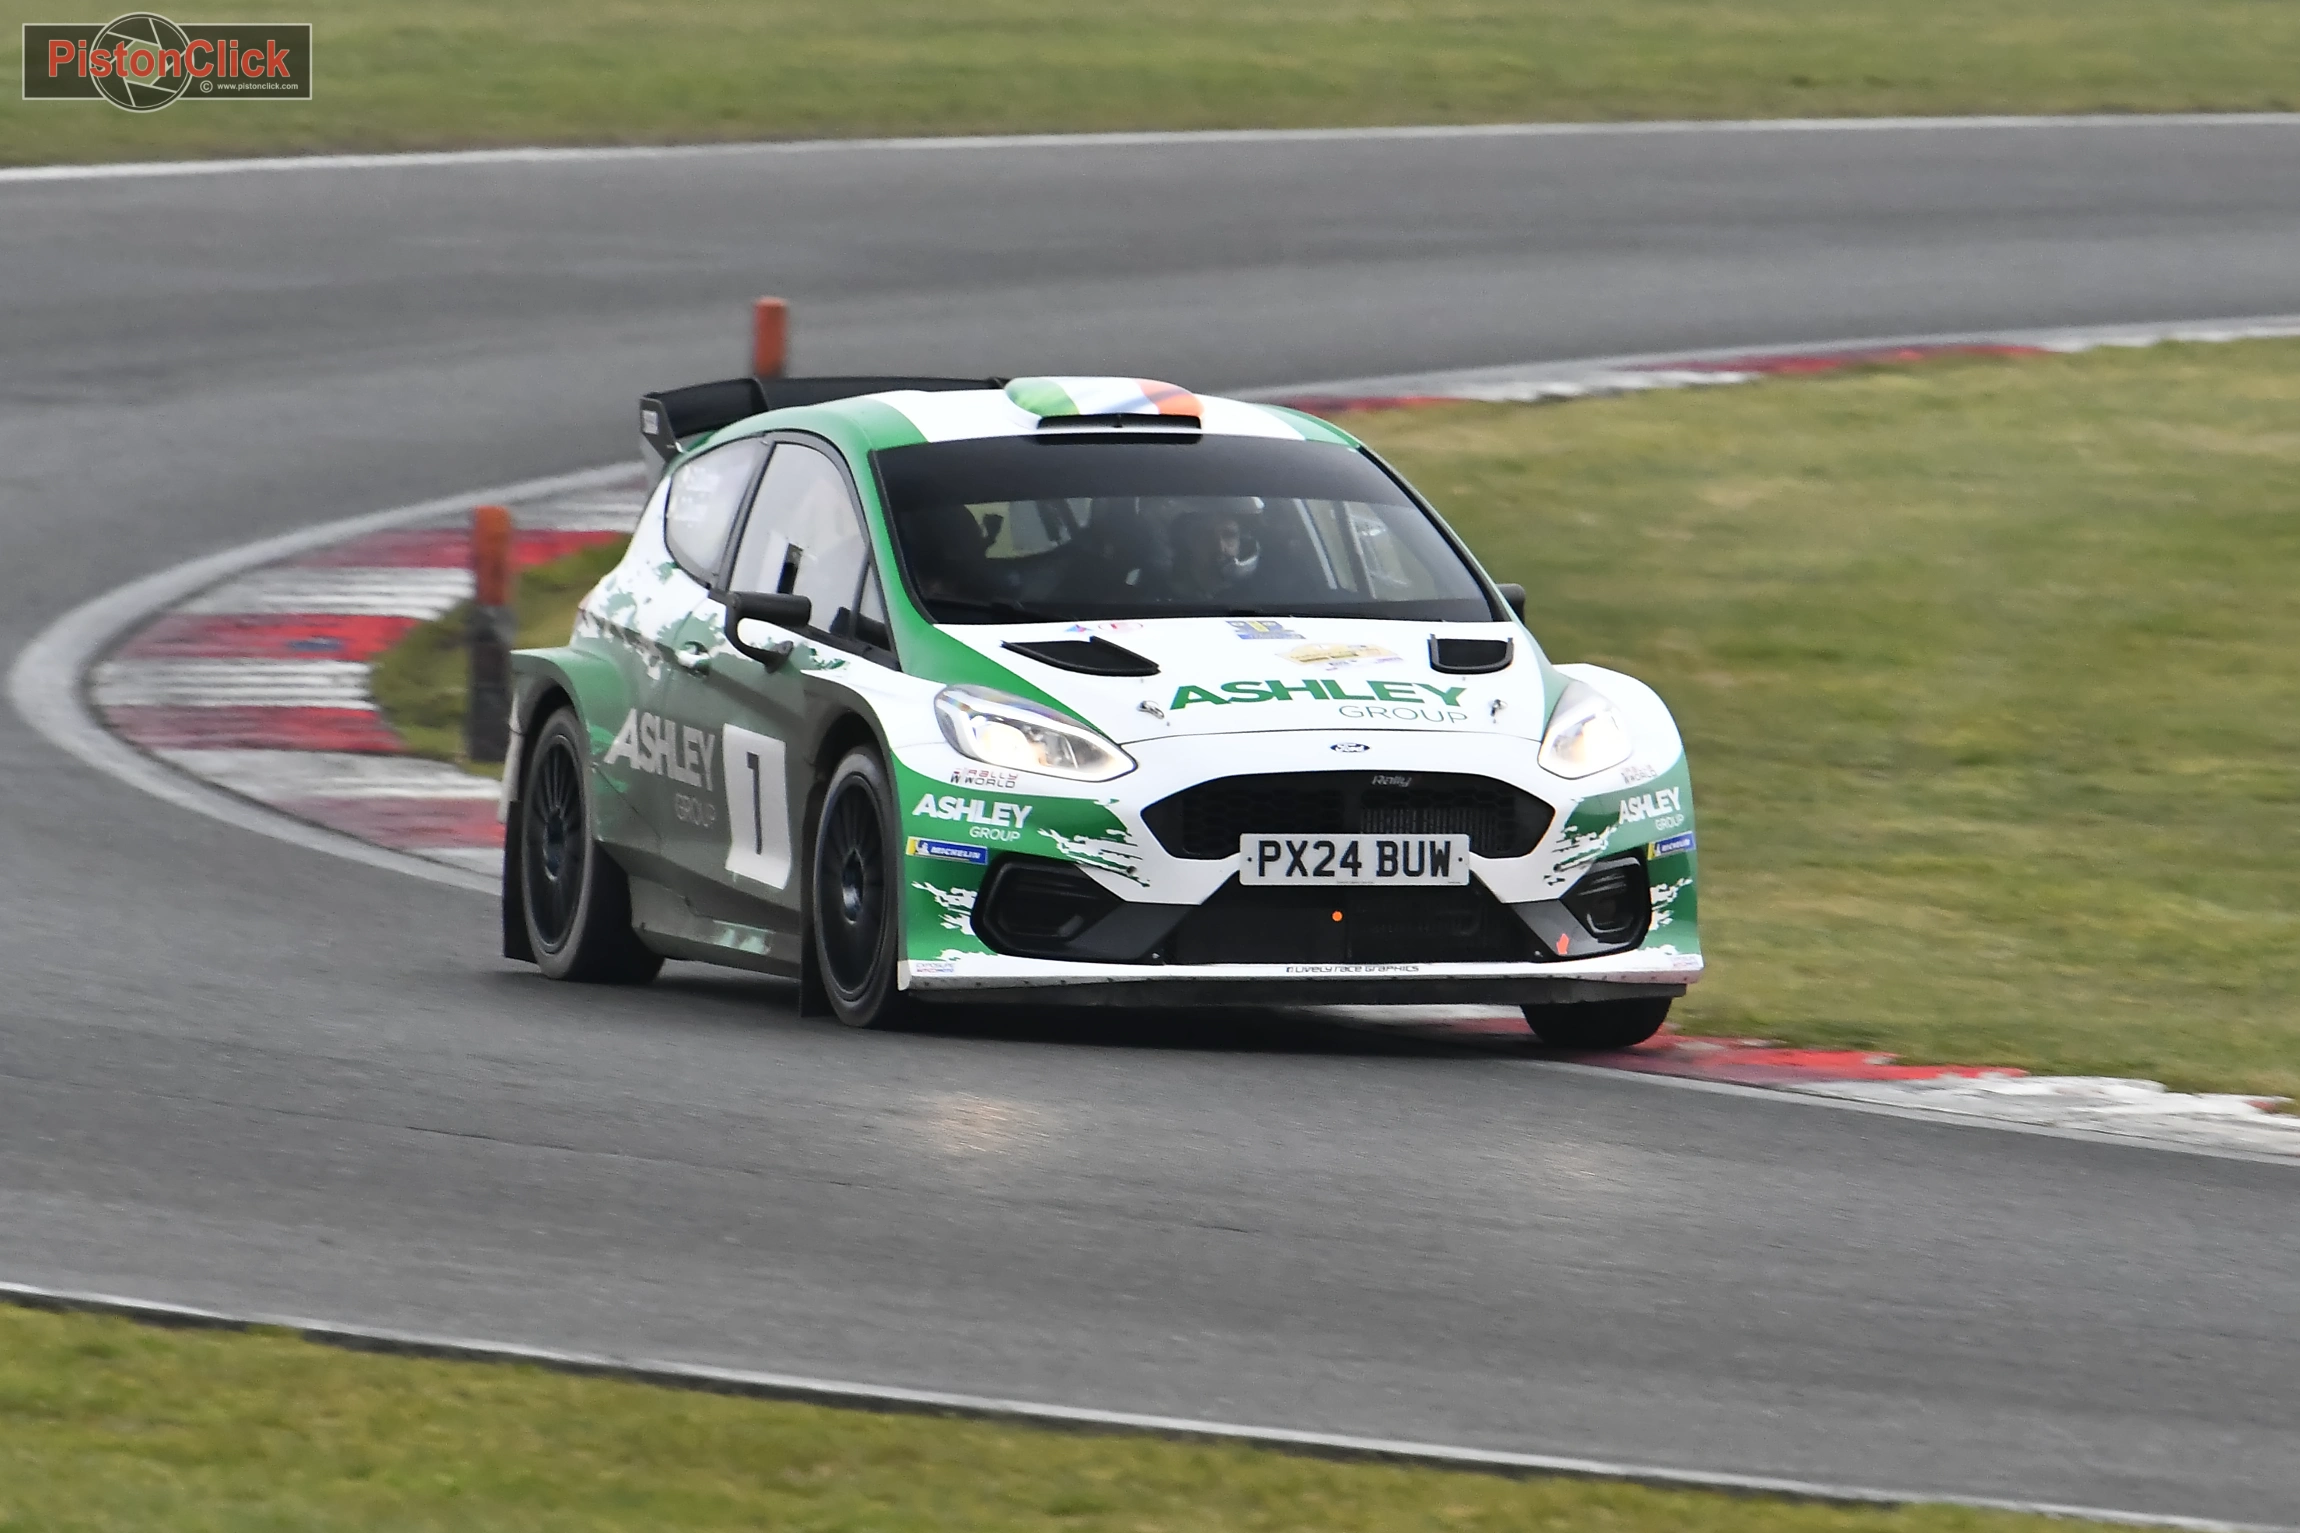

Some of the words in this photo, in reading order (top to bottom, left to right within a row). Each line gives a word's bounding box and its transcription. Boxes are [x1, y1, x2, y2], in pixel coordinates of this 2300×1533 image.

[1169, 679, 1468, 710] ASHLEY
[1339, 705, 1468, 724] GROUP
[603, 708, 715, 792] ASHLEY
[746, 751, 763, 855] 1
[912, 793, 1033, 829] ASHLEY
[1618, 786, 1681, 825] ASHLEY
[969, 826, 1021, 842] GROUP
[1655, 813, 1685, 831] GROUP
[930, 846, 981, 859] MICHELIN
[1258, 840, 1362, 877] PX24
[1376, 840, 1451, 877] BUW
